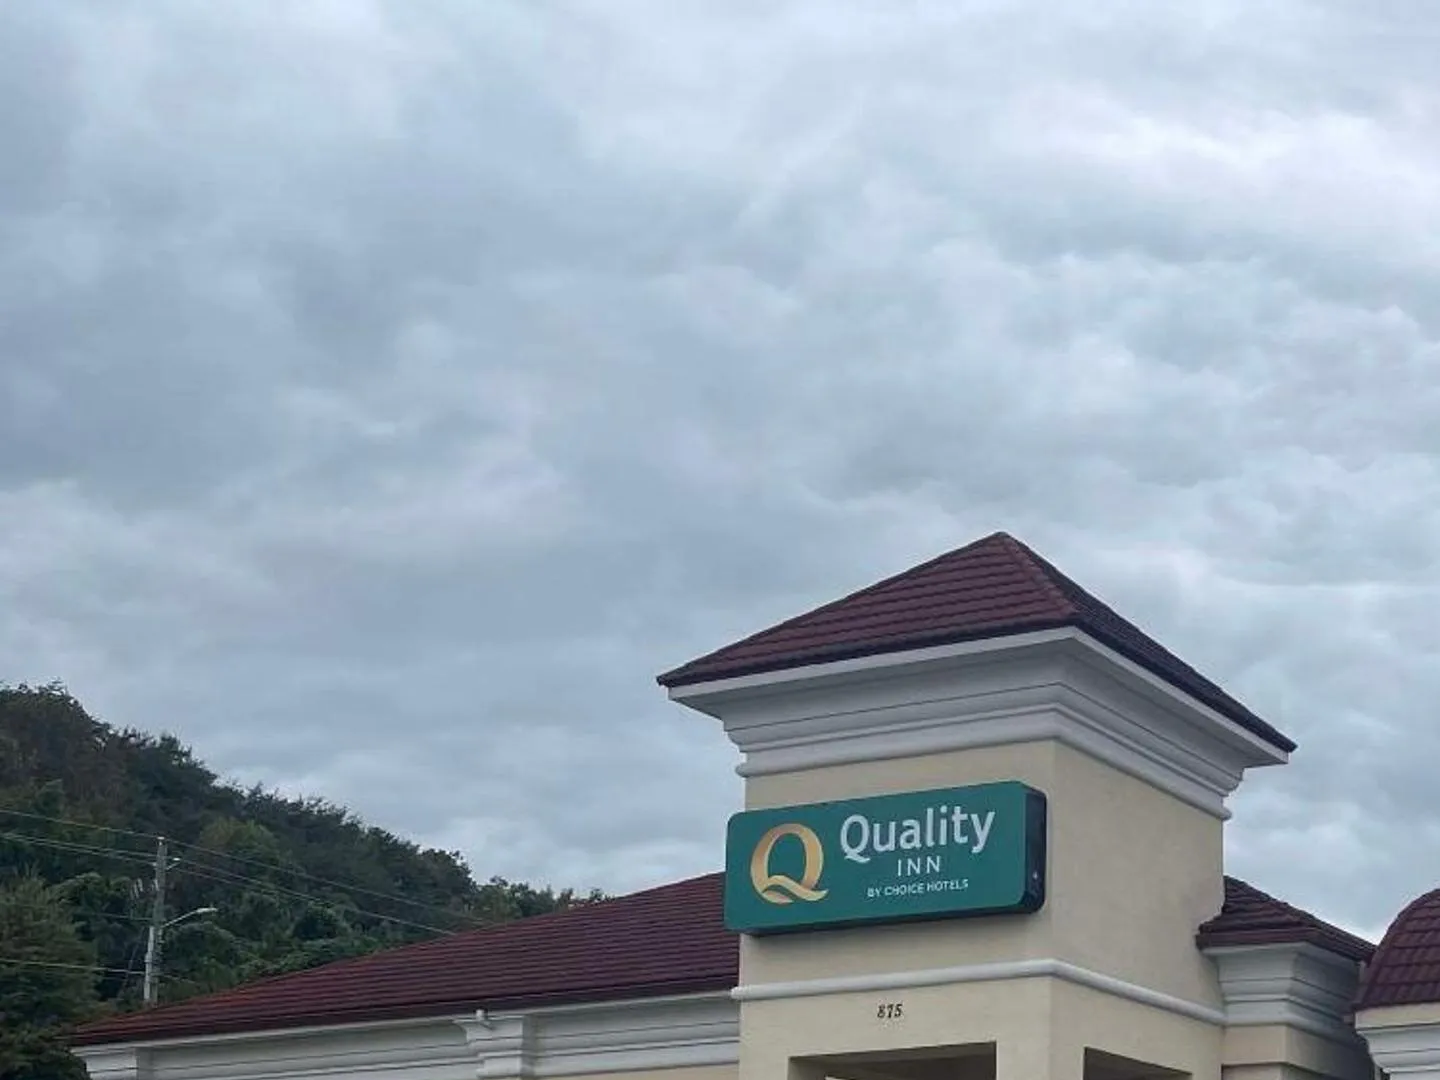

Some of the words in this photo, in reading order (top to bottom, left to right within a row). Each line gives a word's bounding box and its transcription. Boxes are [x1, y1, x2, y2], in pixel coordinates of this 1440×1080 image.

[840, 805, 996, 863] Quality
[750, 823, 829, 904] Q
[897, 855, 942, 876] INN
[867, 887, 881, 897] BY
[884, 883, 924, 896] CHOICE
[926, 879, 969, 892] HOTELS
[877, 1003, 903, 1019] 875
